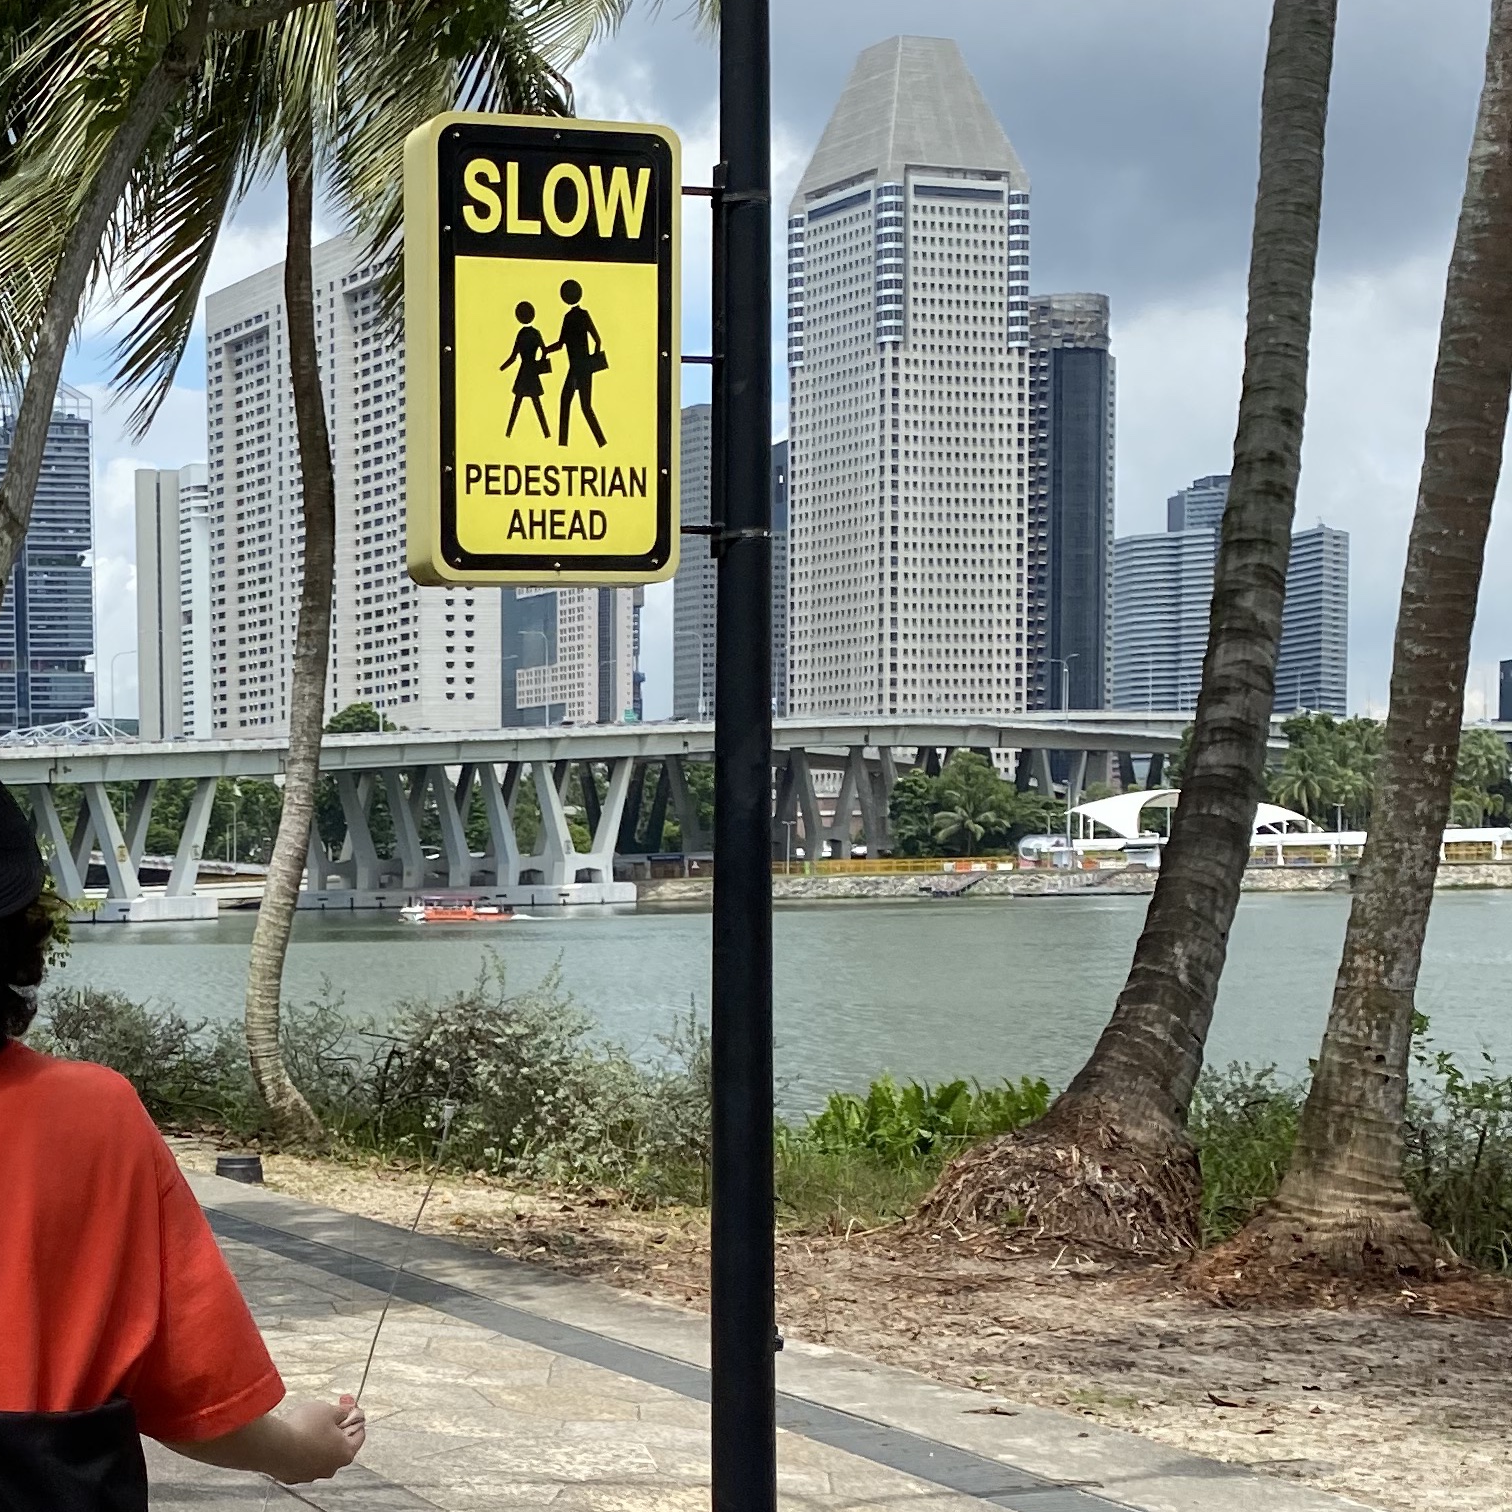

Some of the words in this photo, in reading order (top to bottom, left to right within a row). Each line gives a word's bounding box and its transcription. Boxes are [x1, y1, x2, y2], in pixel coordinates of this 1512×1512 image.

[462, 157, 651, 239] SLOW
[465, 463, 648, 498] PEDESTRIAN
[506, 509, 608, 541] AHEAD
